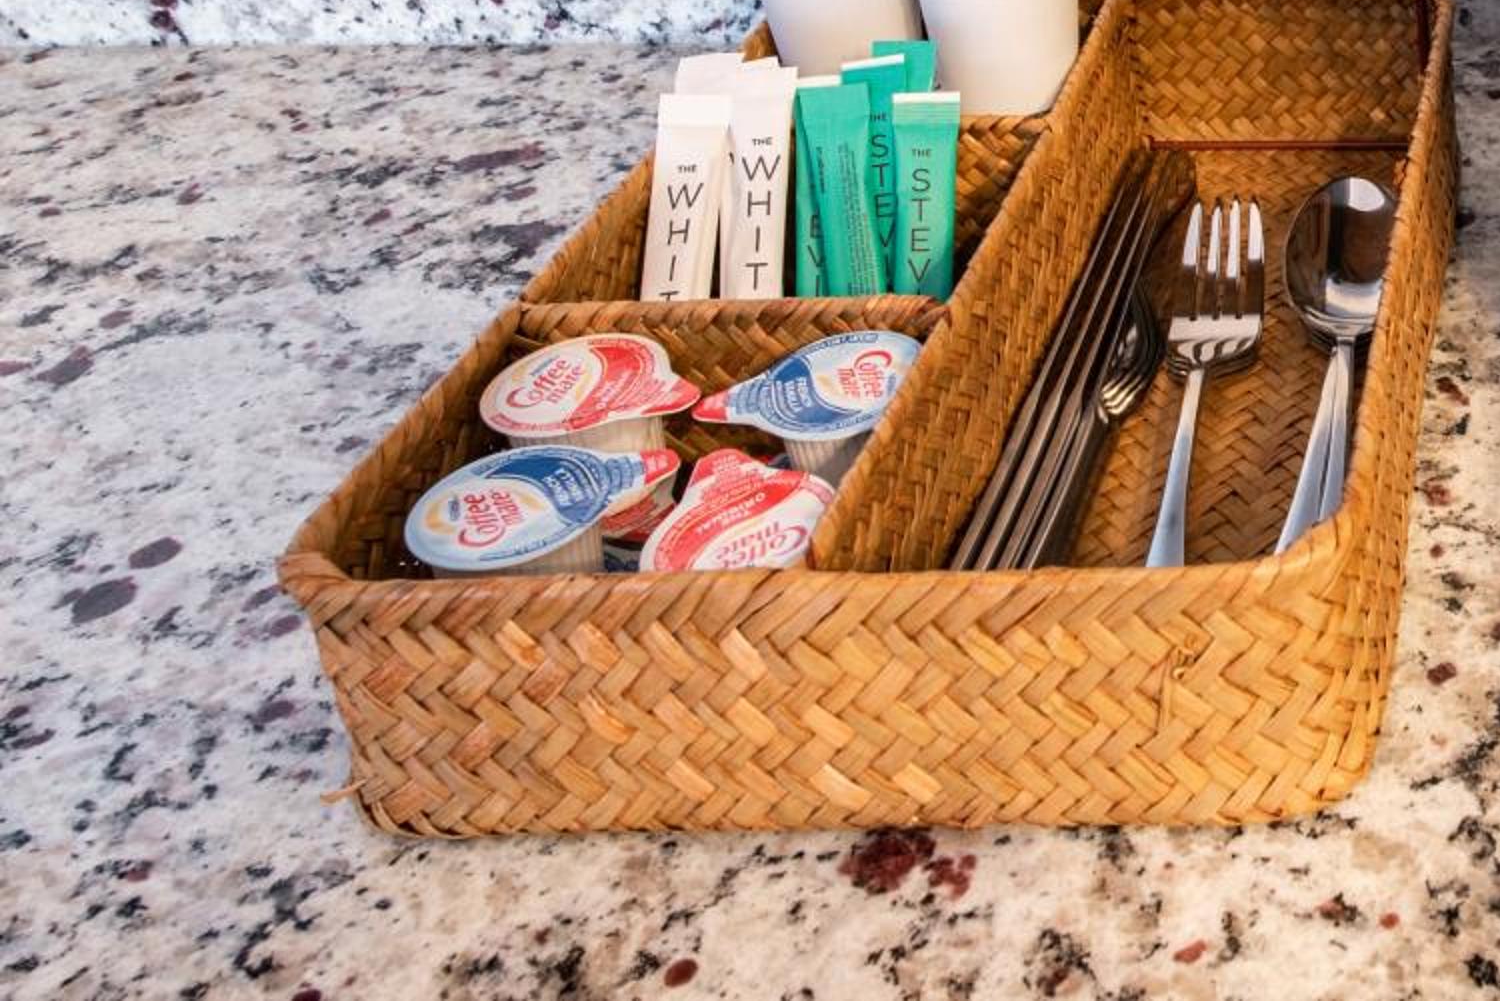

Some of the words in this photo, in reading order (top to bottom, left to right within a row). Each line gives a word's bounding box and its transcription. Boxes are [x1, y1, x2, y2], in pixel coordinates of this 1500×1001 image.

[751, 136, 773, 146] THE
[911, 147, 932, 157] THE
[677, 163, 698, 174] THE
[741, 154, 781, 291] WHIT
[506, 358, 571, 408] Coffee
[545, 361, 585, 405] mate
[854, 350, 893, 398] Coffee
[457, 493, 507, 548] Coffee
